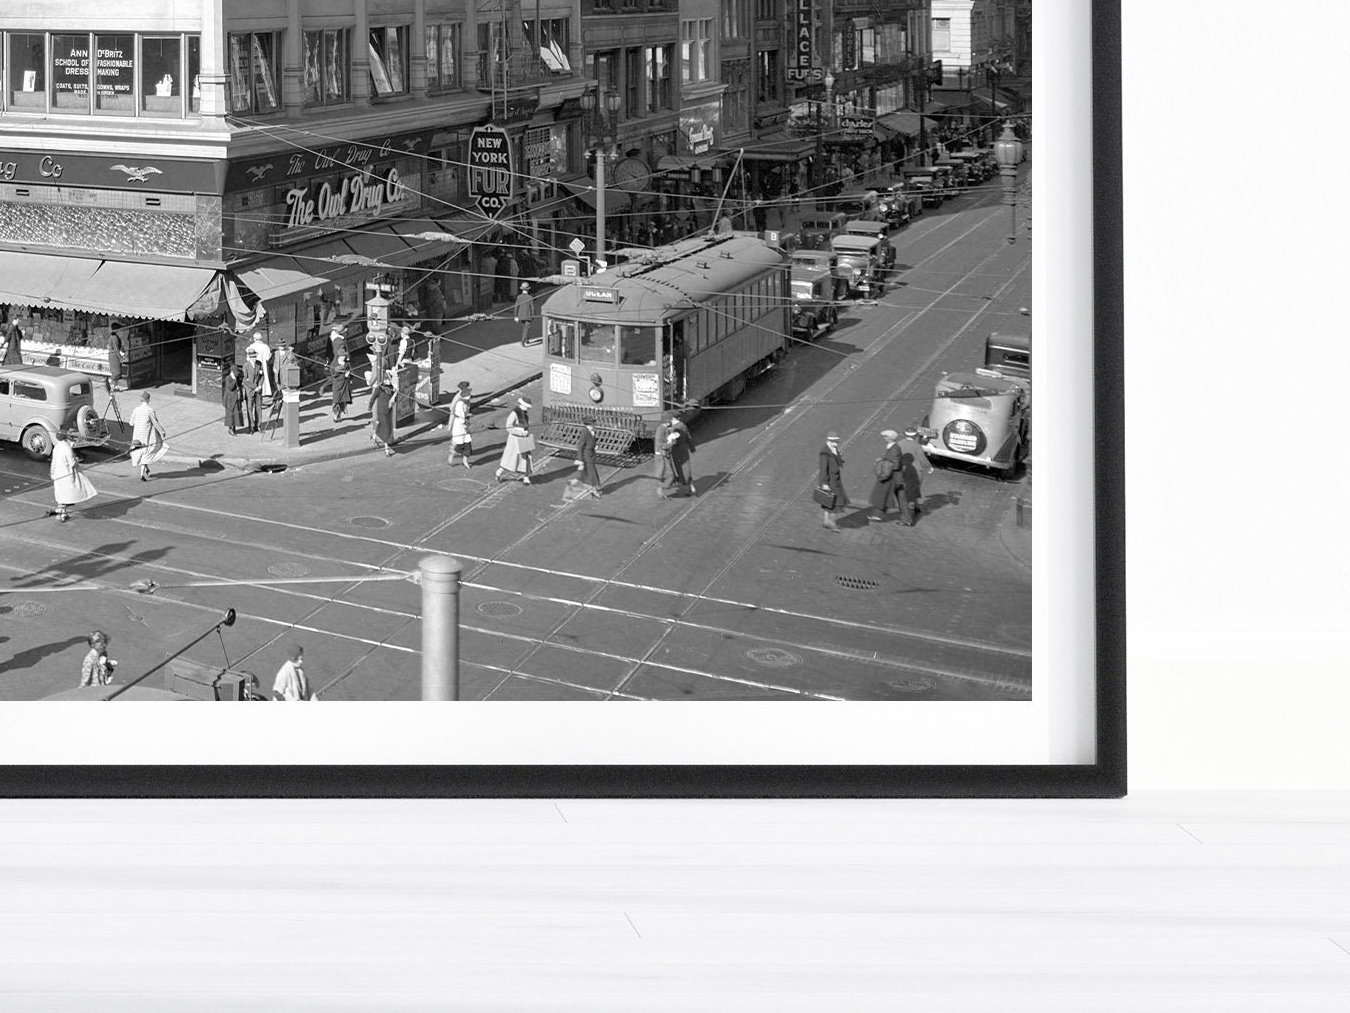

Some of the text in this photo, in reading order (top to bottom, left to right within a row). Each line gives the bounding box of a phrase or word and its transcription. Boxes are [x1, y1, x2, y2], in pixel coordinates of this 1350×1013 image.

[97, 59, 133, 68] FASHIONABLE
[65, 67, 119, 76] DRESS MAKING
[477, 137, 502, 148] NEW
[286, 139, 391, 176] The Owl Drug Co
[472, 152, 507, 163] YORK
[38, 155, 64, 179] Co
[471, 167, 509, 194] FUR
[286, 188, 315, 229] The
[318, 178, 349, 220] Owl
[350, 175, 384, 216] Drug
[481, 197, 501, 208] CO.
[770, 233, 777, 241] B
